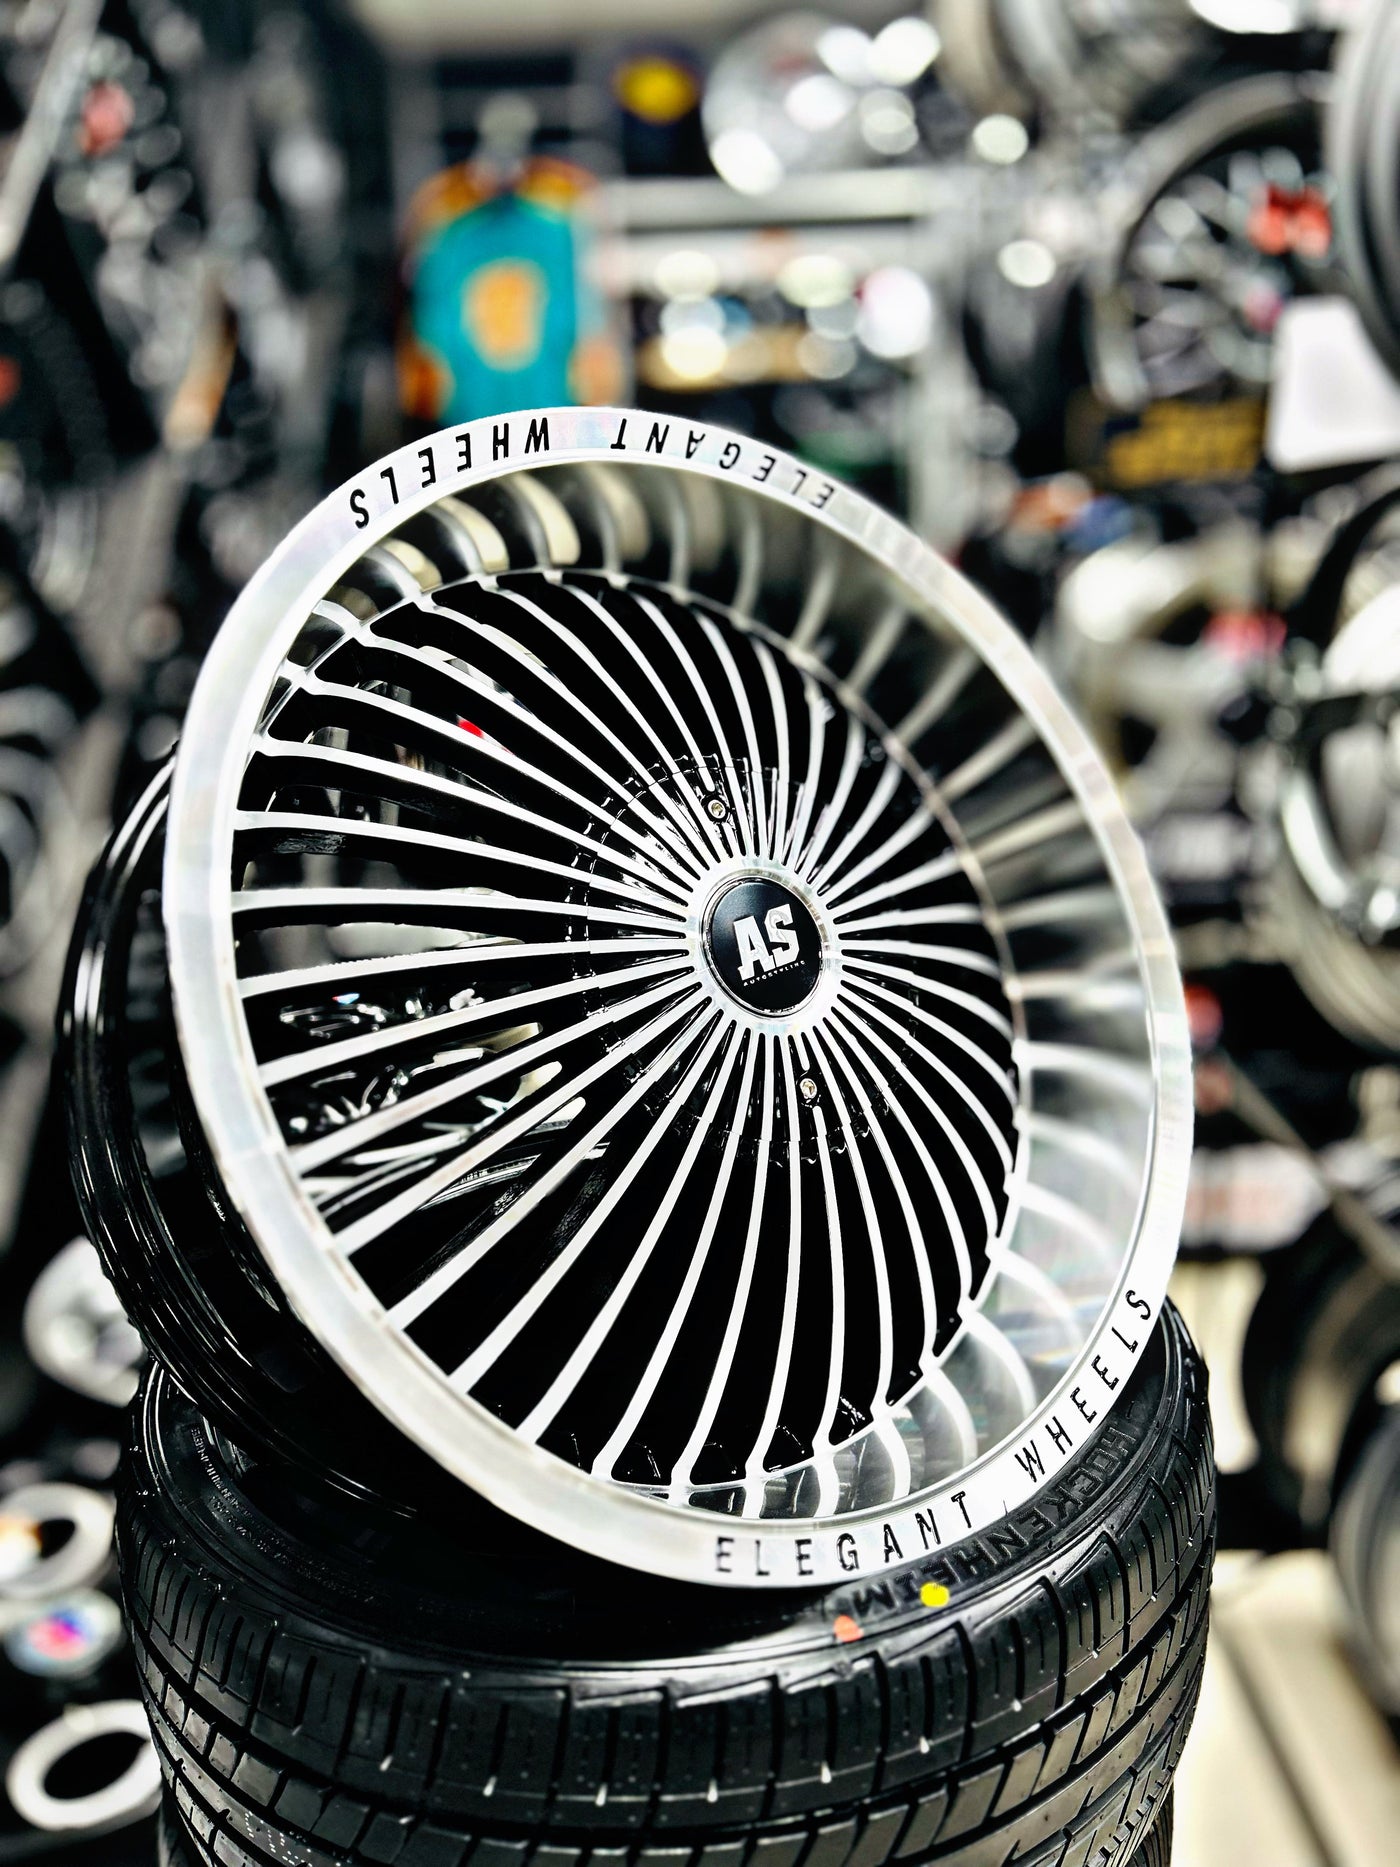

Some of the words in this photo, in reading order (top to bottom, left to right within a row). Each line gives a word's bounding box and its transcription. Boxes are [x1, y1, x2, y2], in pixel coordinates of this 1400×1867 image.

[349, 417, 551, 529] WHEELS
[610, 418, 836, 509] ELEGANT
[733, 903, 800, 980] AS
[715, 1491, 978, 1577] ELEGANT
[1014, 1289, 1152, 1483] WHEELS
